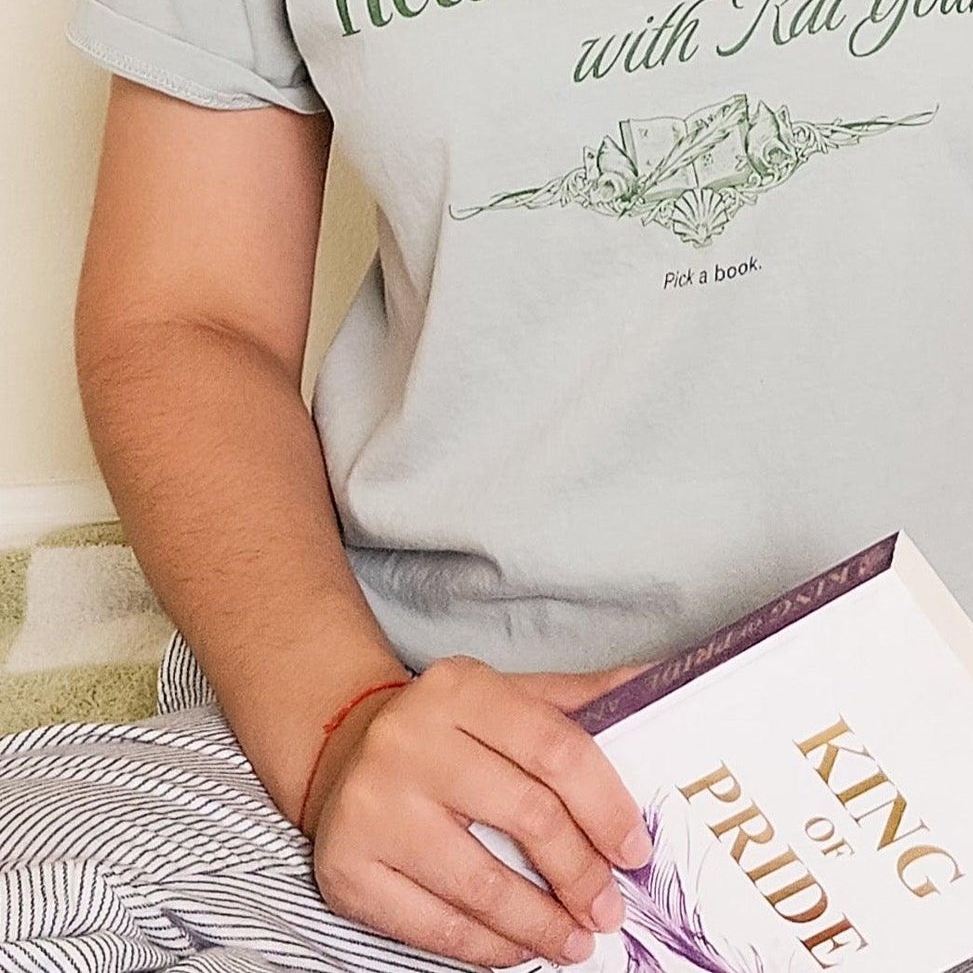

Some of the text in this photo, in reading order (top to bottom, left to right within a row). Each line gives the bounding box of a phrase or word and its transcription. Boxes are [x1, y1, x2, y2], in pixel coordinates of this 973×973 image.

[664, 255, 762, 289] Pick a book.
[792, 712, 964, 898] KING
[804, 816, 855, 861] OF
[676, 760, 869, 970] PRIDE
